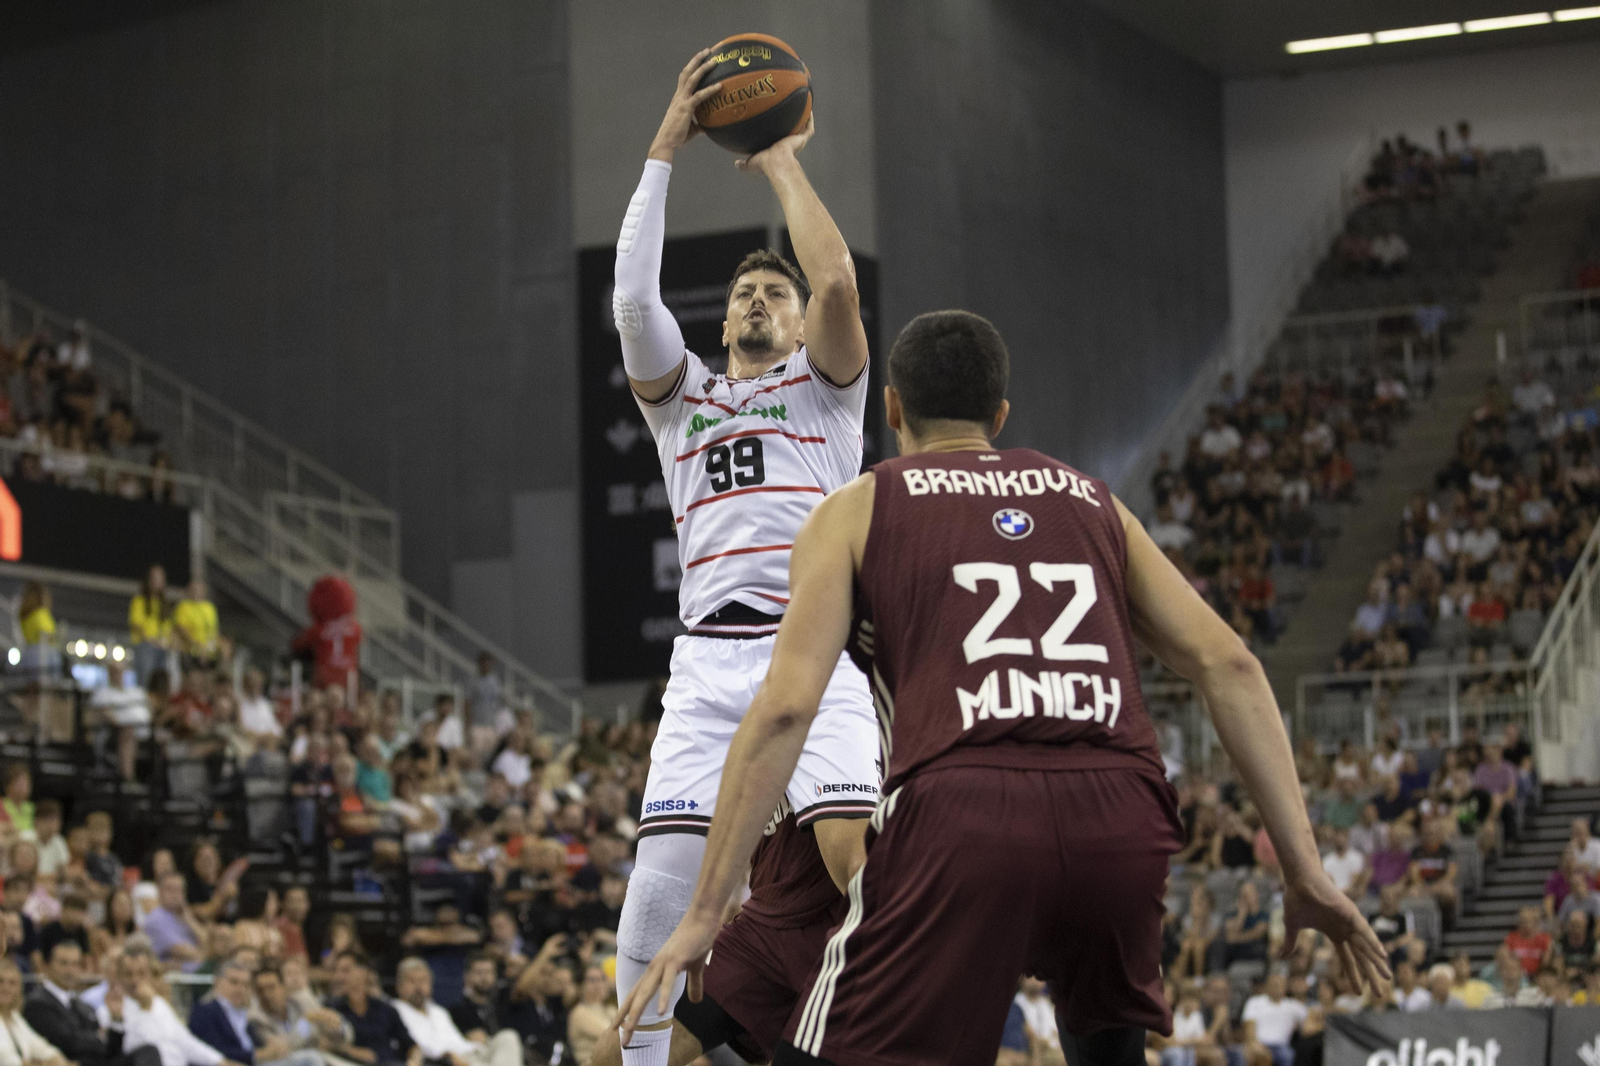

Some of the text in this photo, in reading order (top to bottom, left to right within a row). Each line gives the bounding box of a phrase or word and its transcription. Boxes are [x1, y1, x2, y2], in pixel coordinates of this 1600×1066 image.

[705, 437, 765, 493] 99
[902, 468, 1101, 507] BRANKOVIC
[952, 562, 1108, 664] 22
[956, 668, 1121, 730] MUNICH
[822, 783, 879, 795] BERNER
